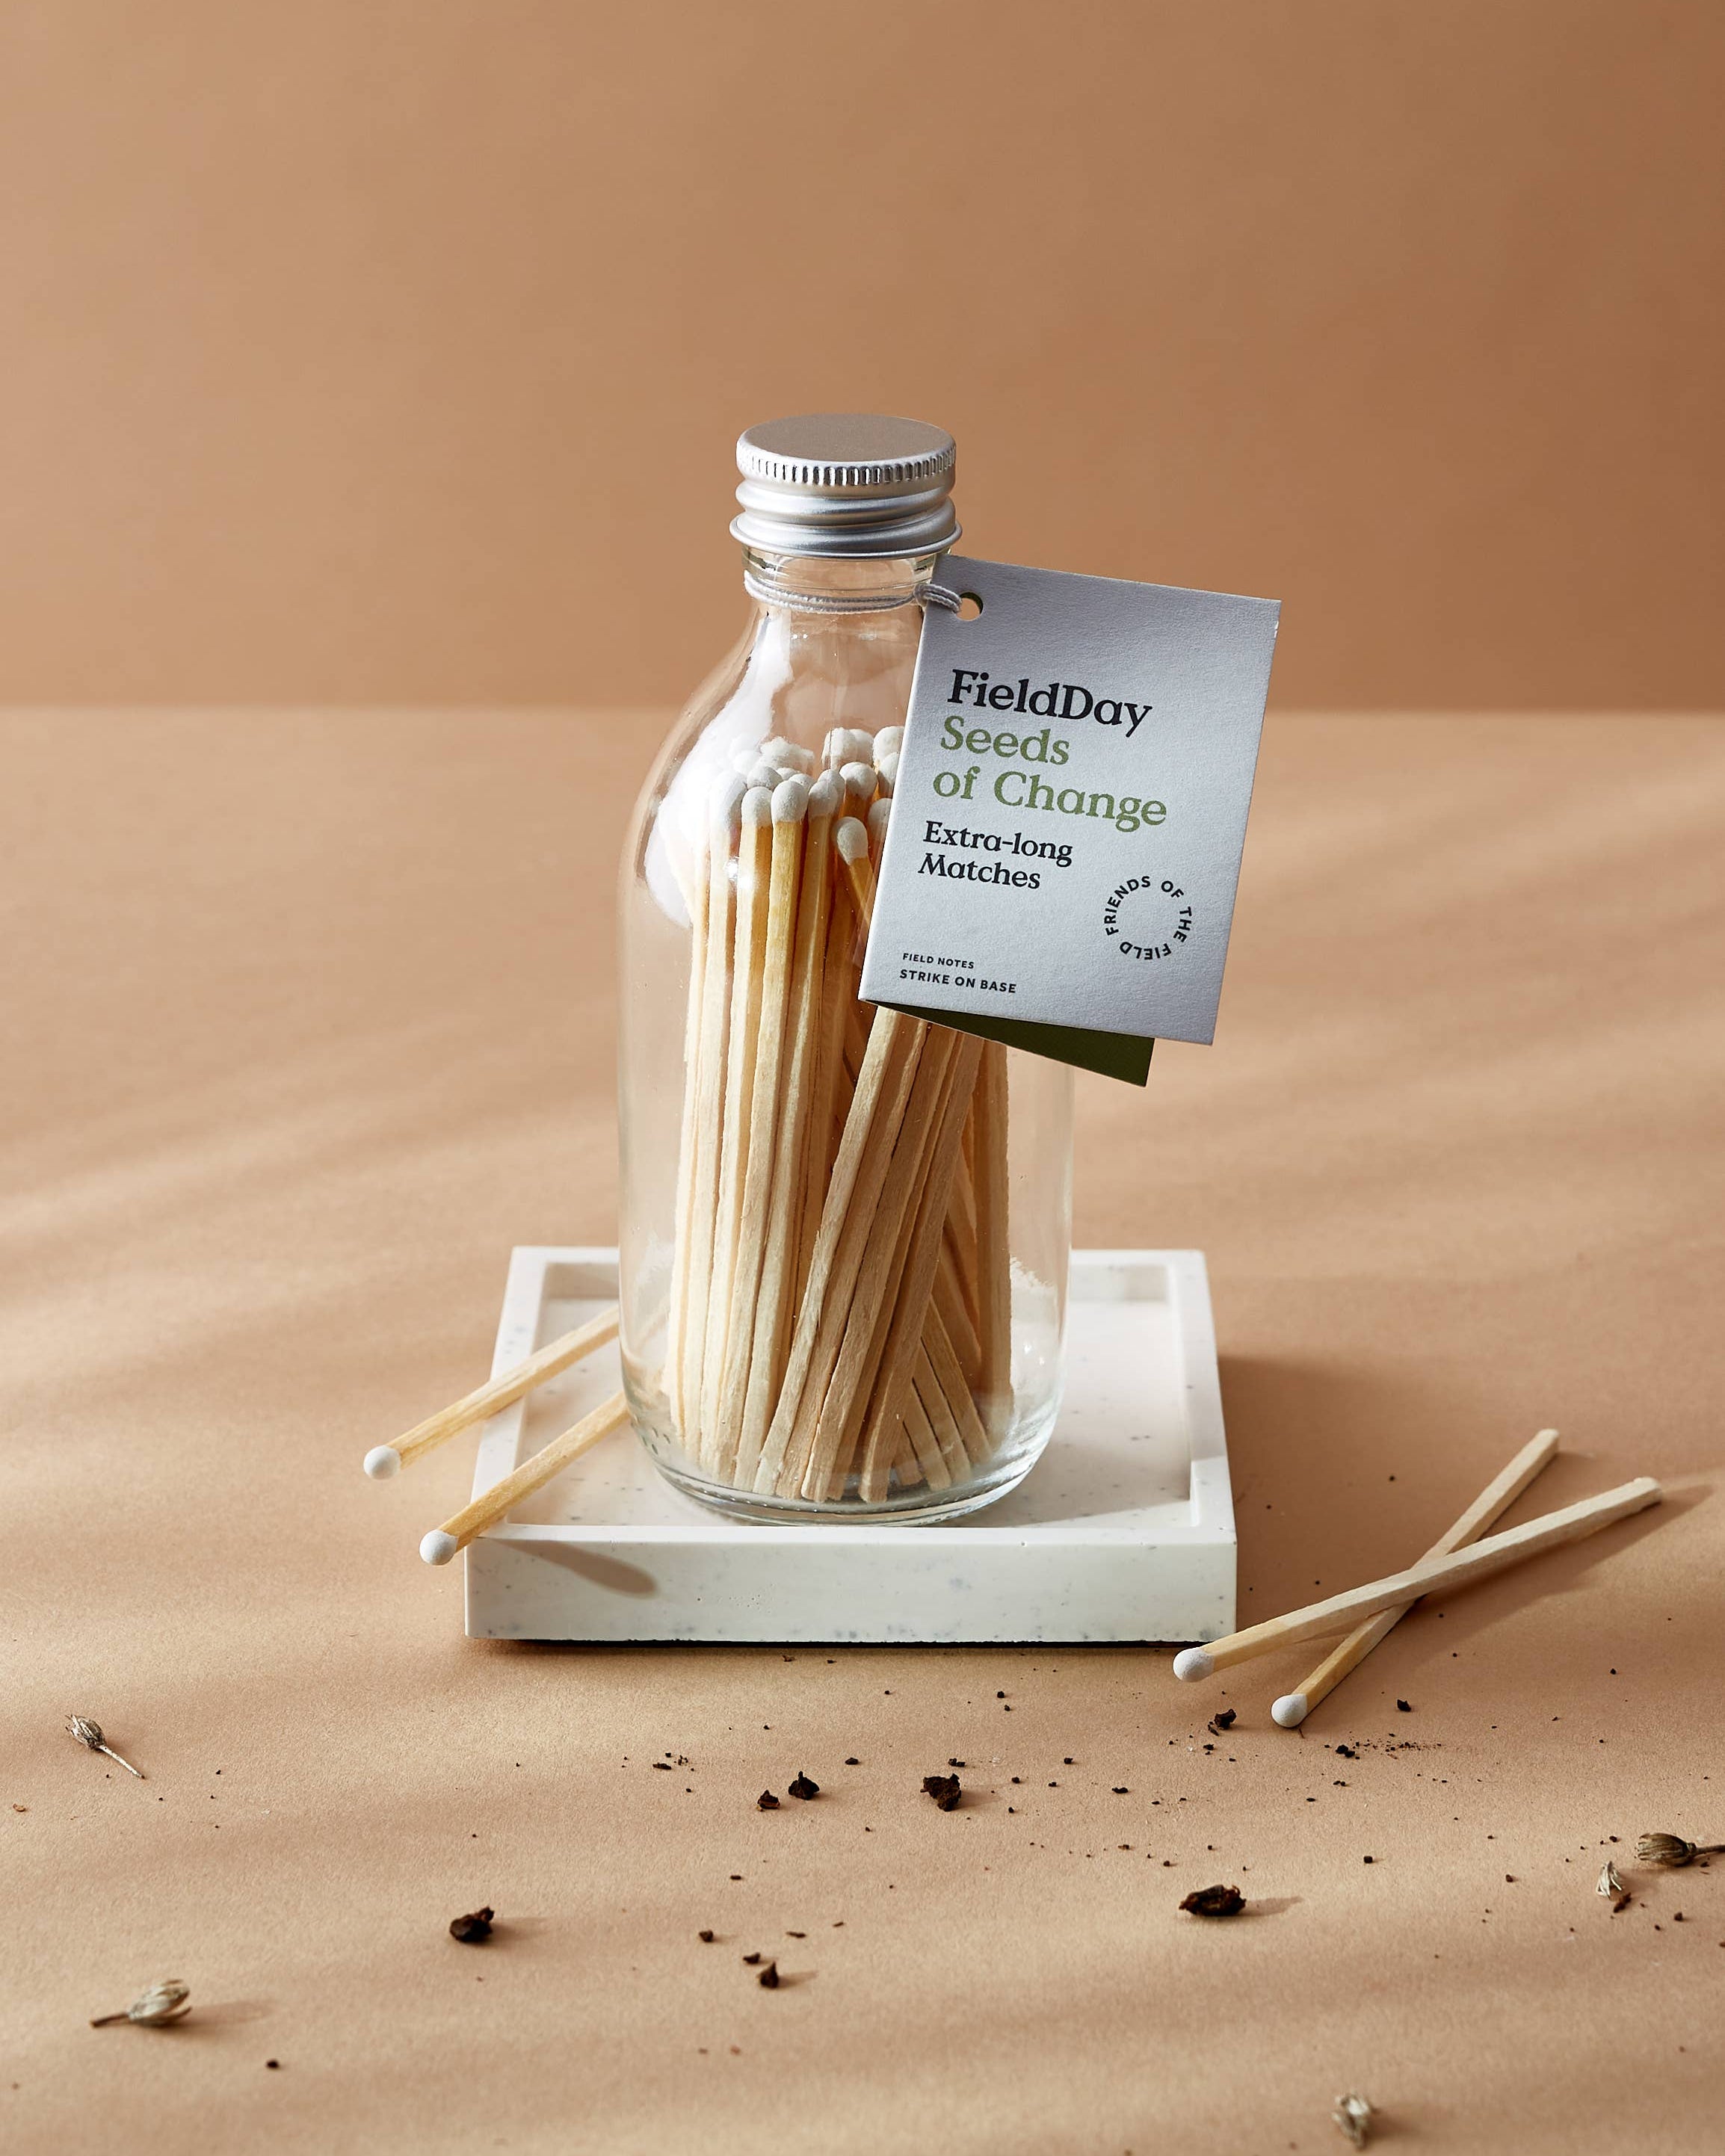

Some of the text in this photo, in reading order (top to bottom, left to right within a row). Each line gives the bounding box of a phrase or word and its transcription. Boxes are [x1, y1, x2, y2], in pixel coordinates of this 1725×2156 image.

[947, 669, 1152, 738] FieldDay
[940, 714, 1070, 766] Seeds
[932, 766, 1167, 833] of Change
[922, 820, 1073, 868] Extra-long
[918, 853, 1041, 890] Matches
[1104, 876, 1192, 960] FRIENDS OF THE FIELD
[899, 969, 1017, 993] STRIKE ON BASE
[902, 953, 975, 969] FIELD NOTES
